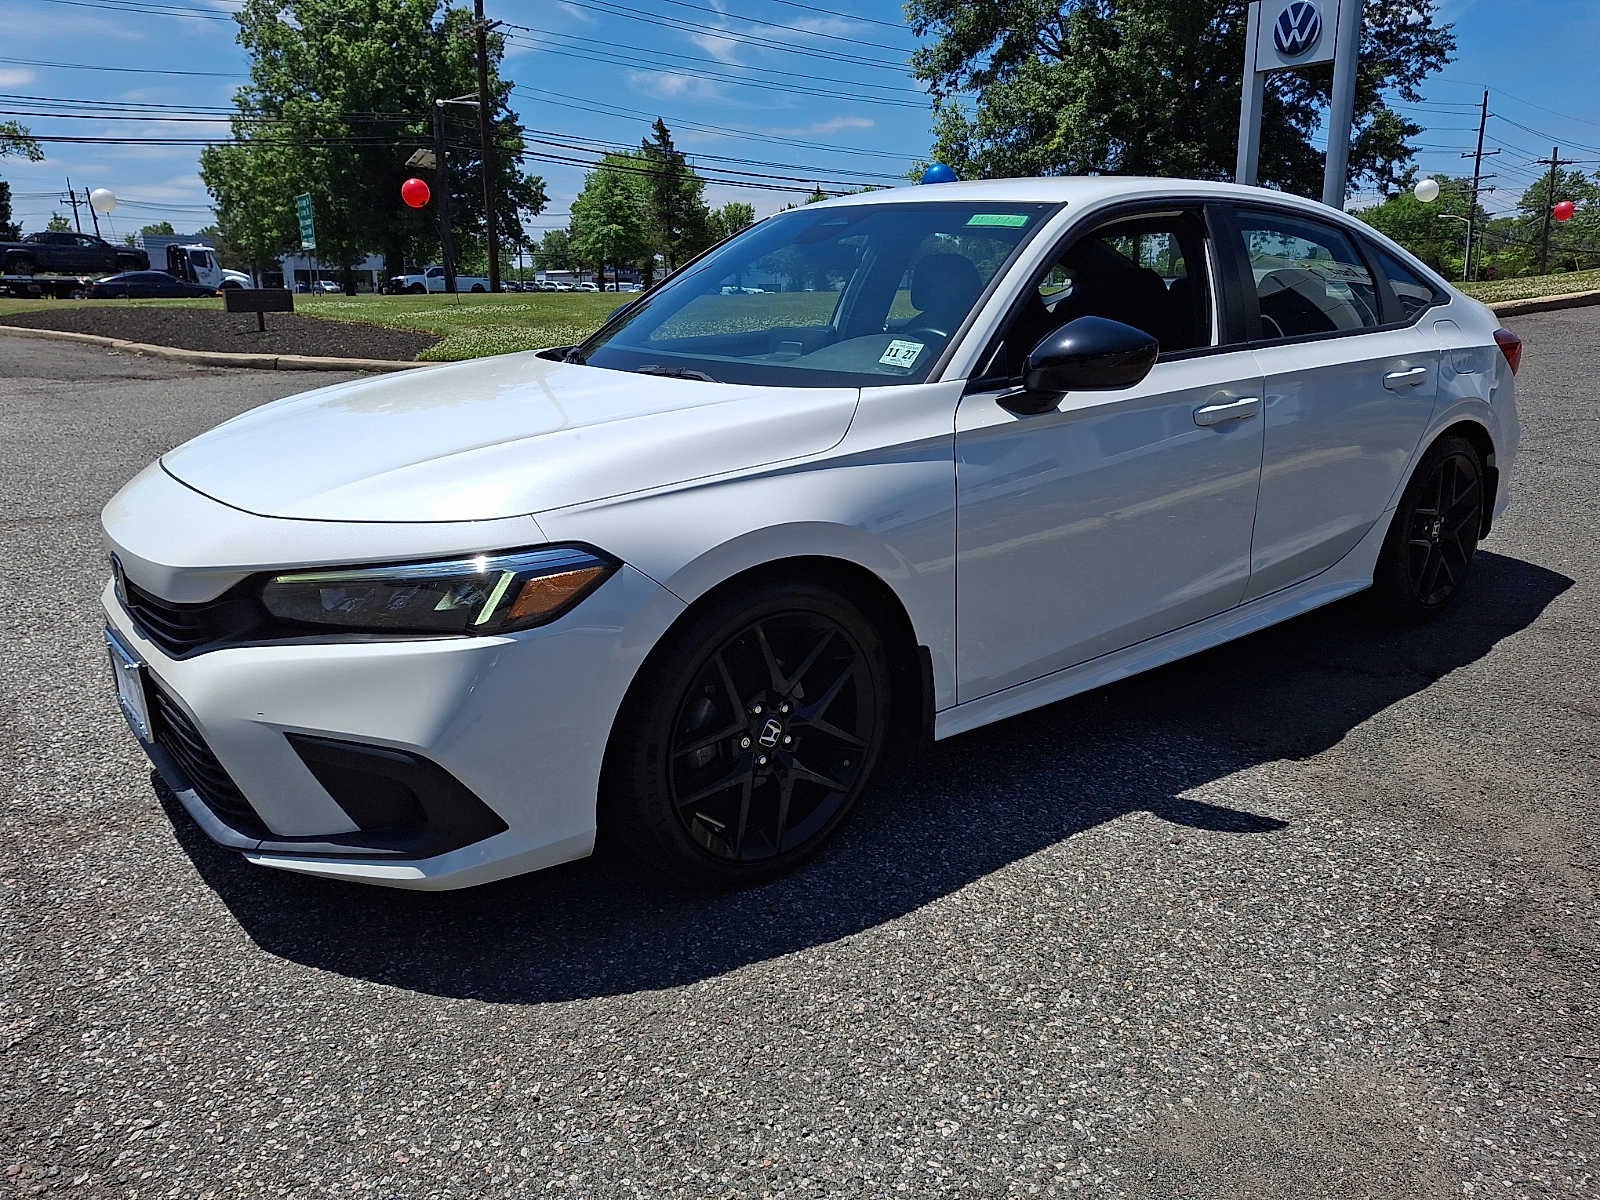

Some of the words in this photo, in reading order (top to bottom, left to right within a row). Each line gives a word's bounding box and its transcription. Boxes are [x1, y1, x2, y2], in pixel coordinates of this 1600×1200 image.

[1275, 2, 1320, 53] VW
[886, 347, 899, 358] 11
[902, 349, 916, 360] 27
